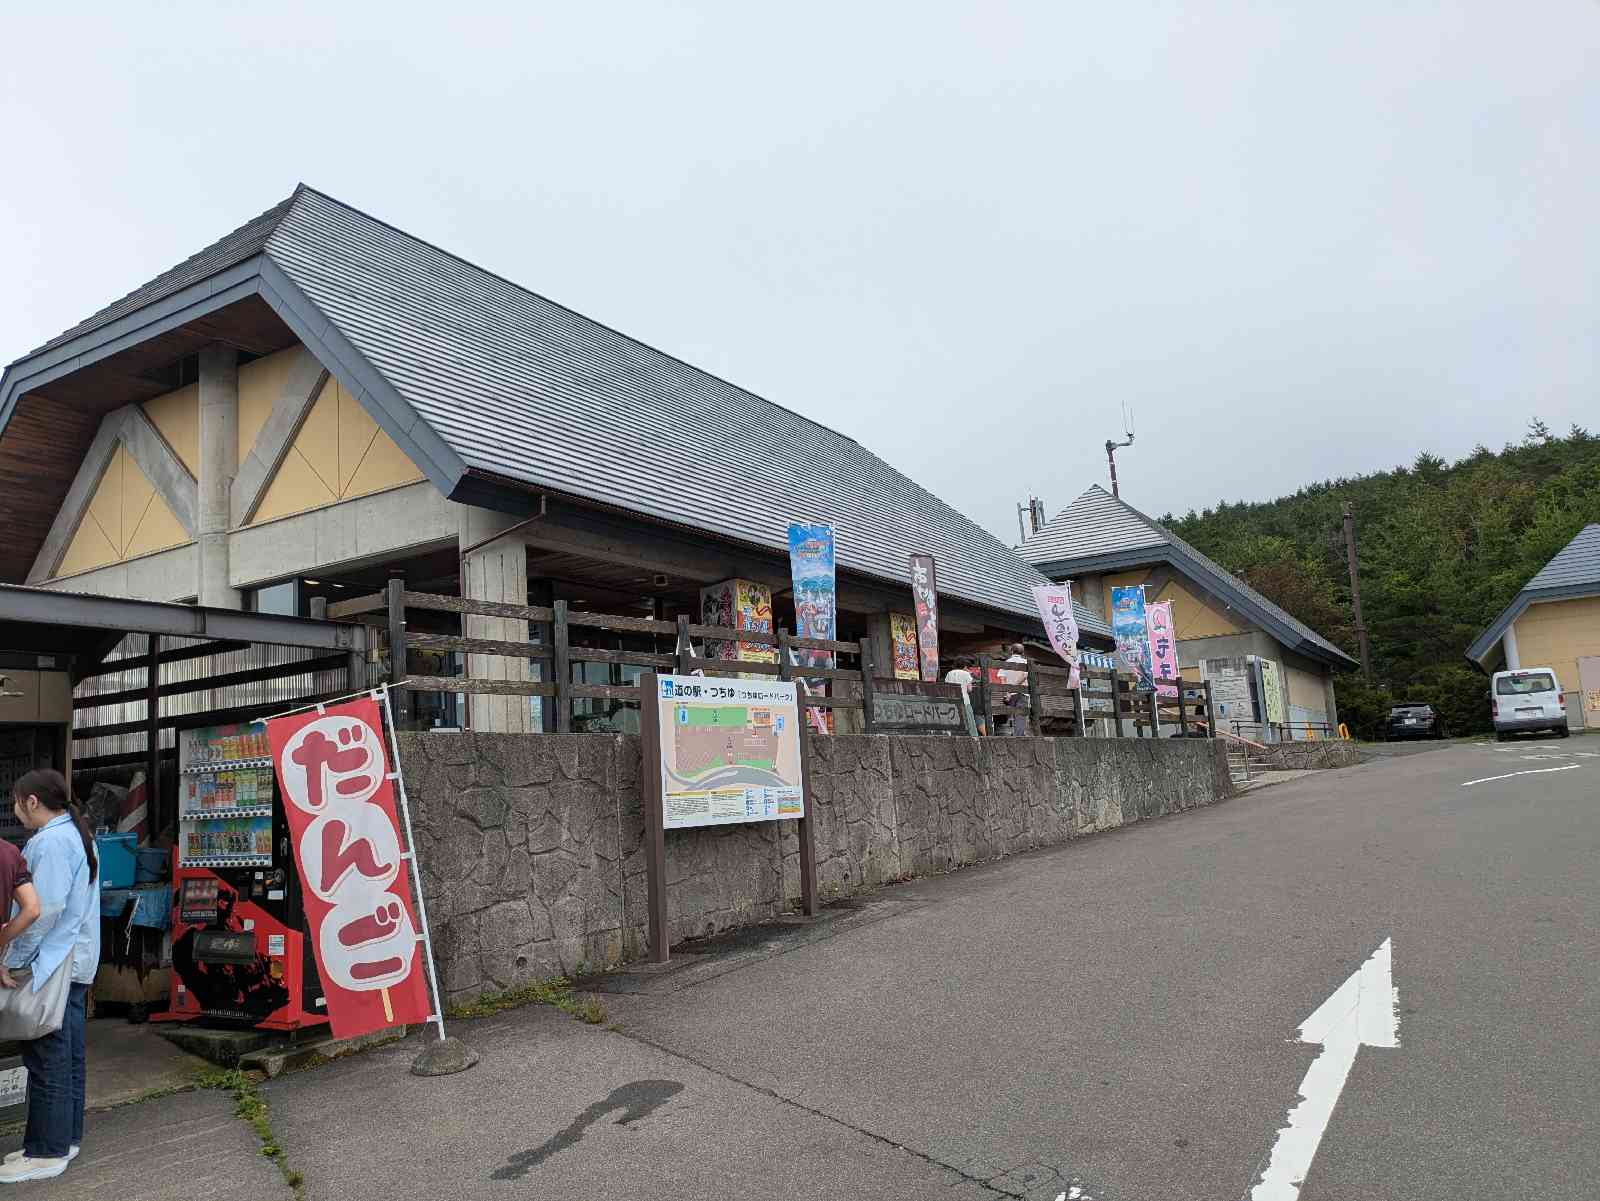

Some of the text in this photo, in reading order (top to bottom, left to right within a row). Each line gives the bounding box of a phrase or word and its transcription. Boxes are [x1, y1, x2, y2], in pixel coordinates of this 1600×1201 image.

[674, 684, 735, 698] 道の駅・つちゆ
[291, 724, 404, 981] だんご
